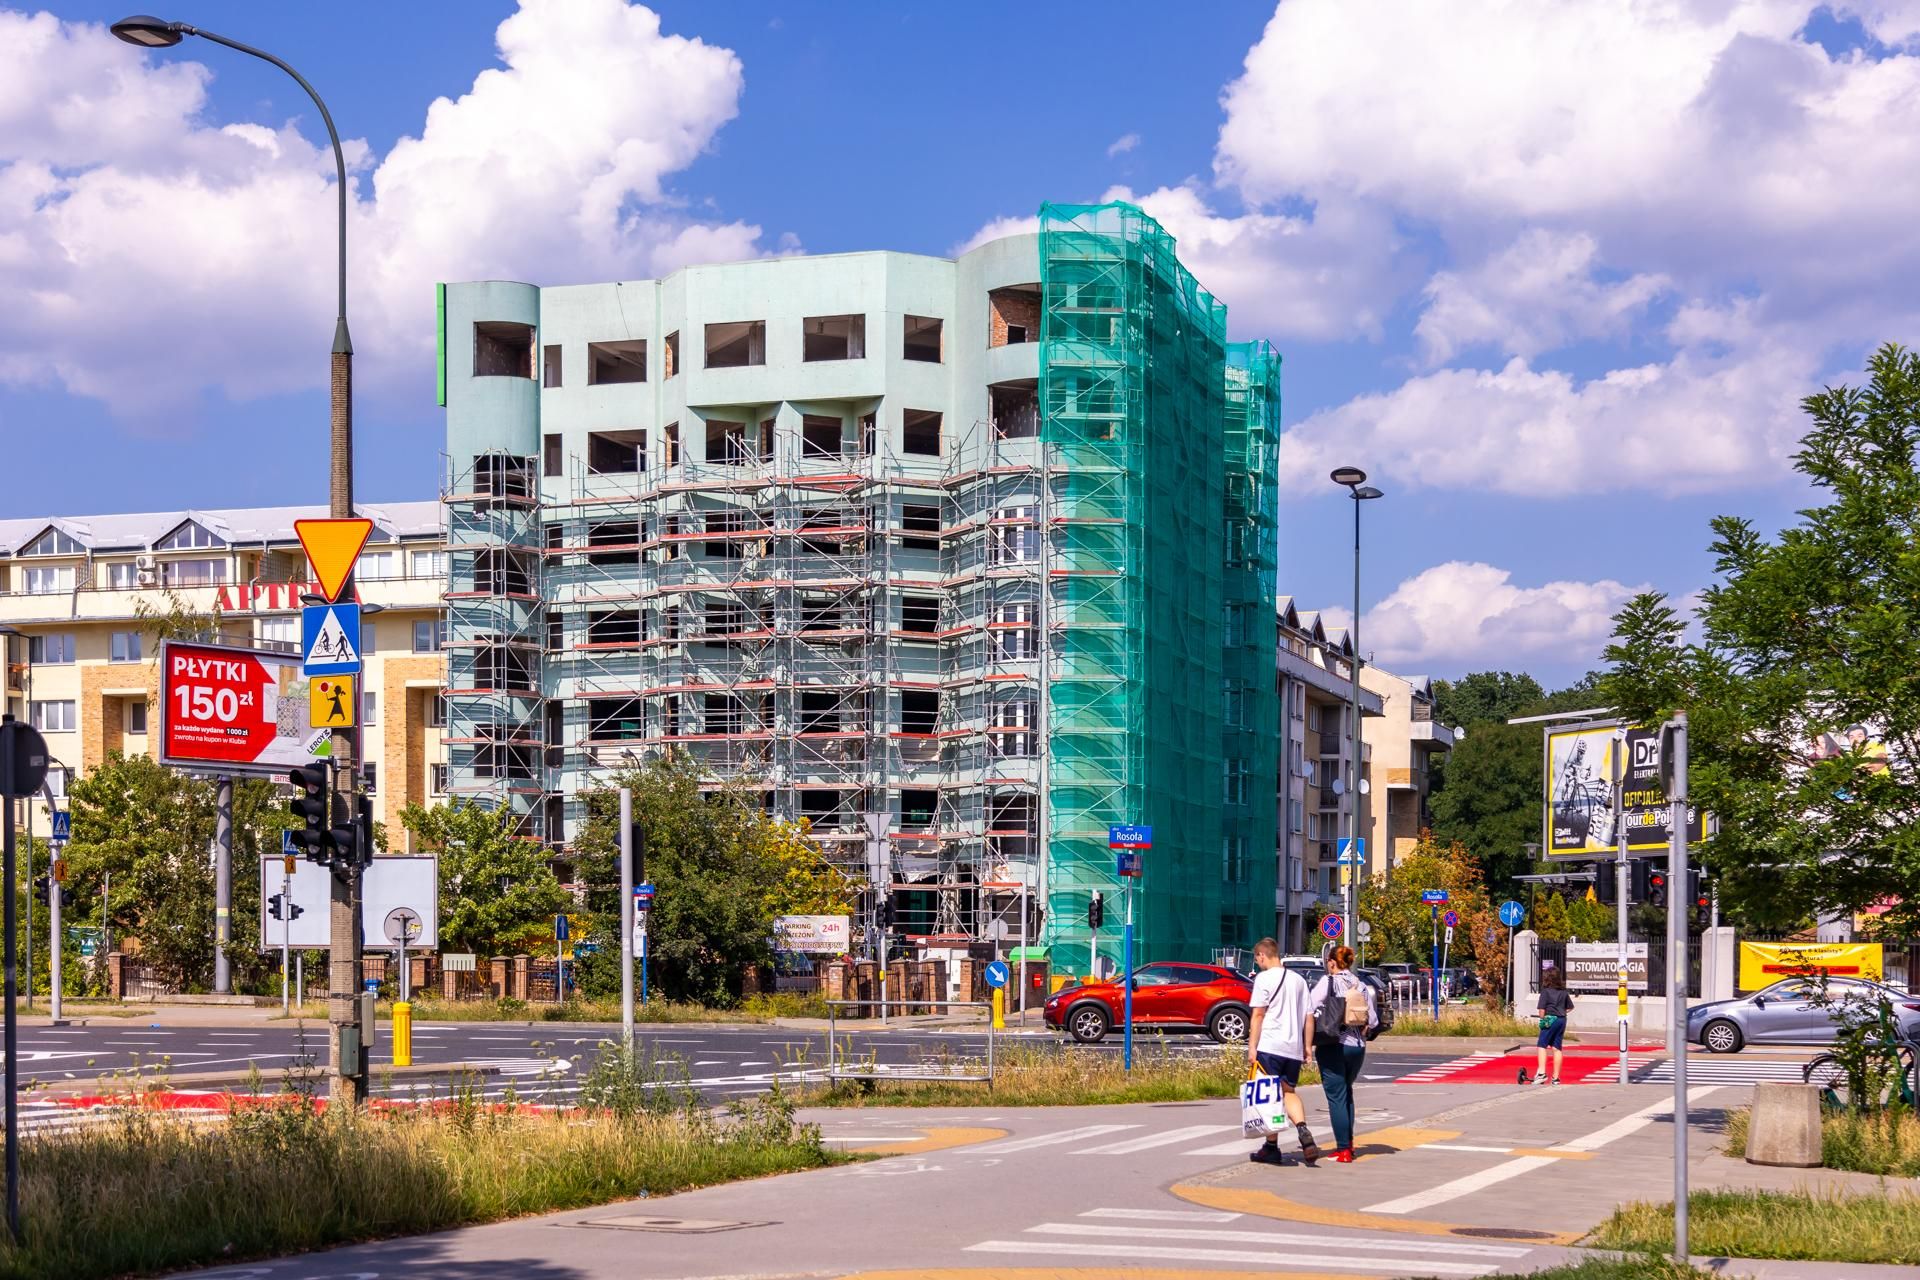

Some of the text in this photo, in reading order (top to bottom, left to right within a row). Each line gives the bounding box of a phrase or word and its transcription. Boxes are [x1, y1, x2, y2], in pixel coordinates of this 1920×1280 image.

[211, 583, 363, 611] APTE
[174, 656, 247, 682] PŁYTKI
[306, 732, 326, 755] LEROY
[1116, 831, 1143, 841] Rosoła
[822, 923, 839, 932] 24h
